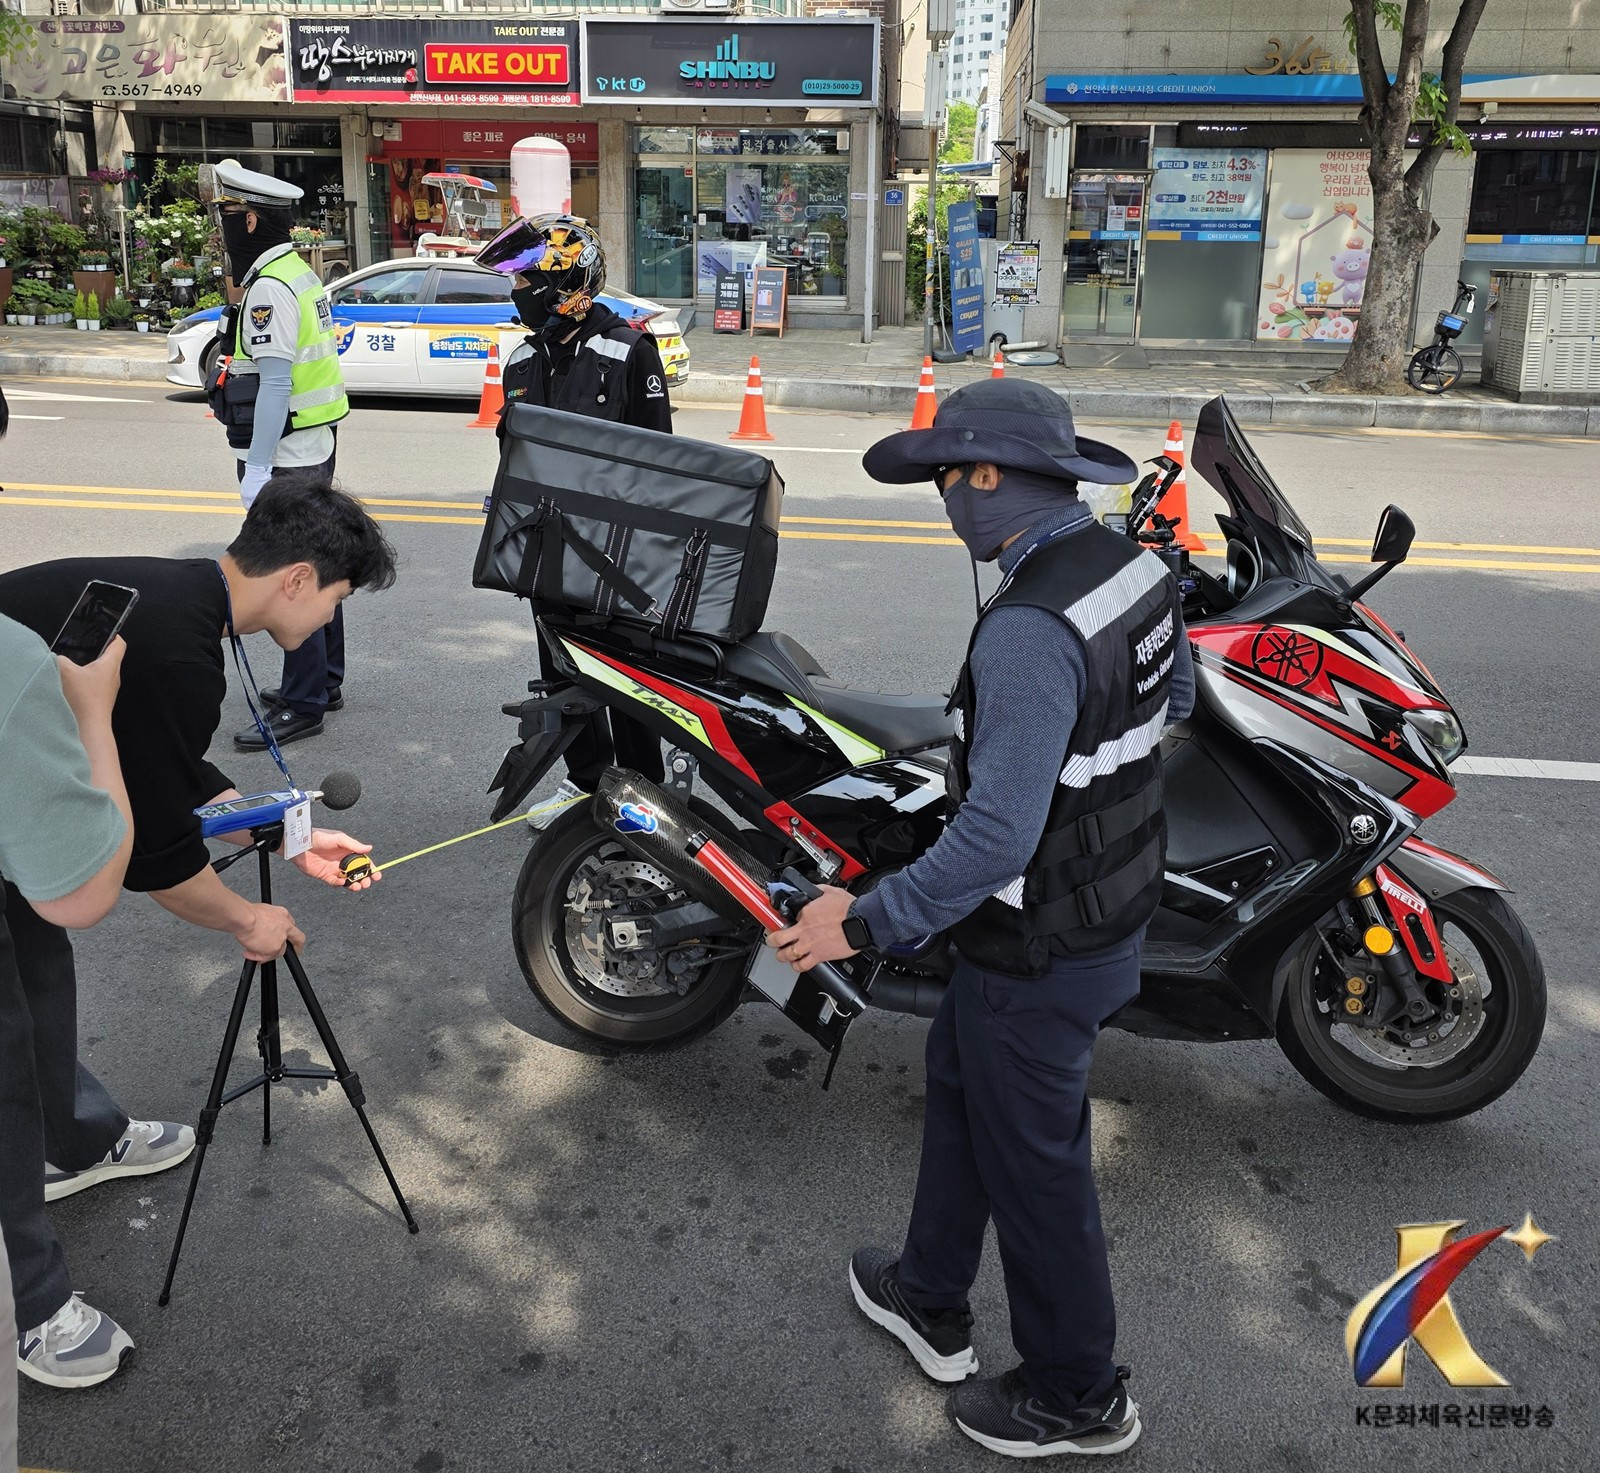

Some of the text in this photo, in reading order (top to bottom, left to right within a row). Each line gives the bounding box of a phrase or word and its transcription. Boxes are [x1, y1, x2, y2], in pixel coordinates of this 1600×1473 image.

[95, 22, 120, 31] 서비스
[494, 27, 565, 36] TAKE OUT 전문점
[1244, 36, 1332, 75] 365
[432, 52, 561, 75] TAKE OUT
[679, 60, 776, 80] SHINBU
[612, 77, 626, 90] kt
[1083, 84, 1216, 94] 천안신협신부지점 CREDIT UNION
[444, 94, 499, 102] 041-563-8599
[531, 95, 571, 103] 1811-8599
[463, 131, 482, 143] 좋은
[484, 131, 504, 143] 재료
[566, 132, 586, 144] 음식
[1326, 151, 1371, 161] 어서오세요
[1319, 163, 1369, 173] 행복이 넘치
[1210, 173, 1225, 182] 최고
[1323, 175, 1351, 185] 우리집
[1323, 186, 1371, 197] 신협입니다
[366, 334, 396, 352] 경찰
[432, 340, 496, 352] 충청남도 자치경
[1136, 669, 1160, 695] Vehicle
[631, 680, 698, 727] TMAX
[1381, 878, 1427, 914] PIRELLI
